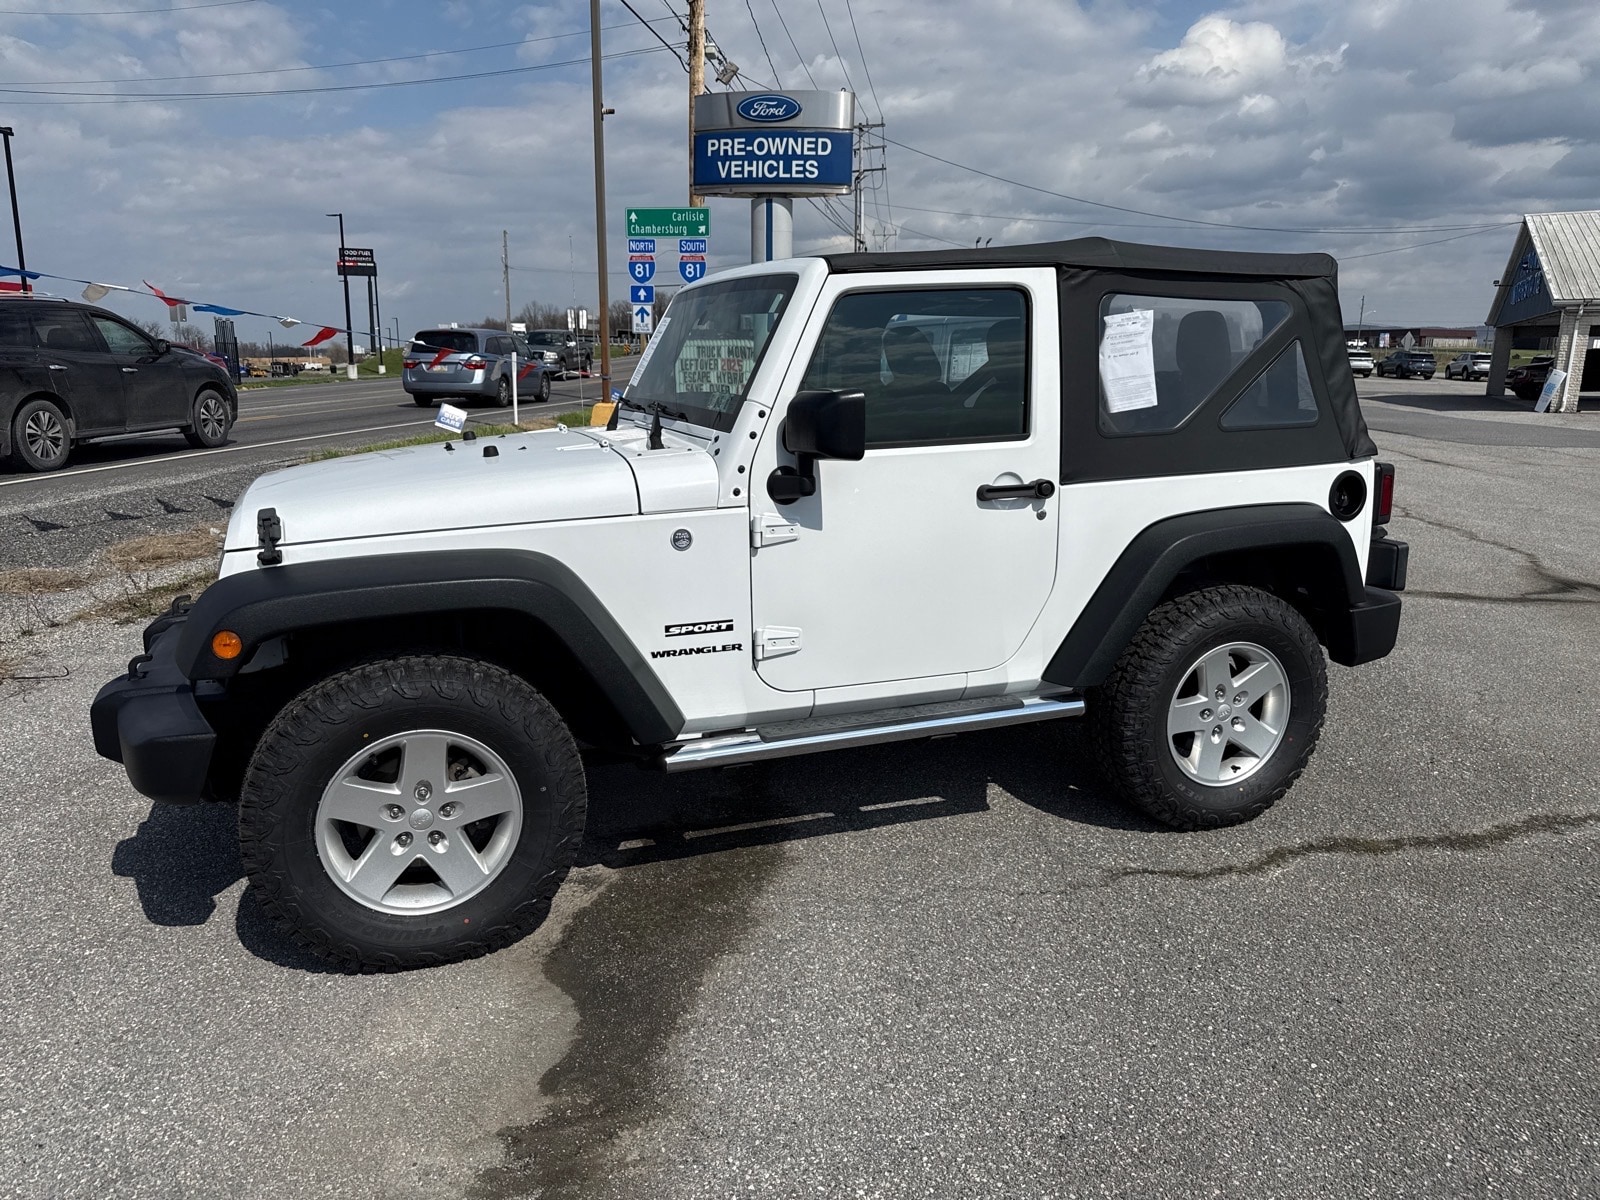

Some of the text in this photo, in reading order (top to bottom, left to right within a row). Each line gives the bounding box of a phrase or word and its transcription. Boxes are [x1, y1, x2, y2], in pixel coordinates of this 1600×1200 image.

[750, 101, 787, 116] Ford
[707, 137, 832, 157] PRE-OWNED
[717, 160, 819, 179] VEHICLES
[672, 211, 704, 222] Carlisle
[630, 224, 688, 236] Chambersburg
[629, 240, 654, 251] NORTH
[681, 241, 705, 251] SOUTH
[634, 263, 650, 278] 81
[685, 263, 700, 278] 81
[696, 346, 722, 358] TRUCK
[721, 360, 743, 372] 2025
[684, 371, 711, 383] ESCAPE
[710, 384, 730, 394] OVER
[440, 416, 460, 427] CARS
[667, 622, 733, 635] SPORT
[650, 643, 743, 659] WRANGLER
